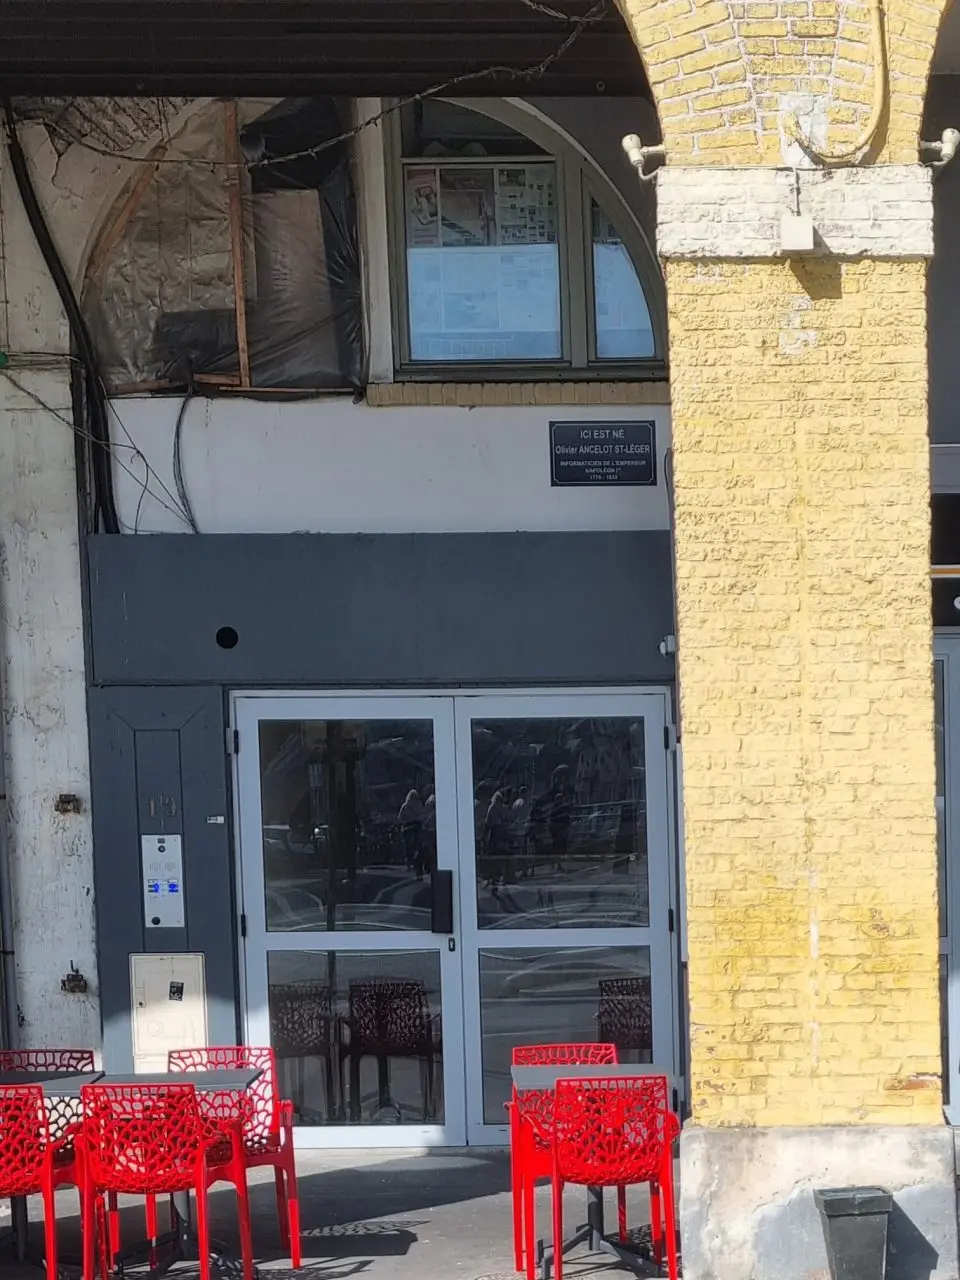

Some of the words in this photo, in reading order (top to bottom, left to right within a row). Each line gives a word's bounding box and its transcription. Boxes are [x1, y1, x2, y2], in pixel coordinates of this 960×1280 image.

[580, 430, 591, 439] ICI
[593, 430, 610, 439] EST
[612, 428, 625, 439] NÉ
[555, 445, 578, 454] Olivier
[579, 445, 613, 454] ANCELOT
[614, 443, 650, 454] ST-LÉGER
